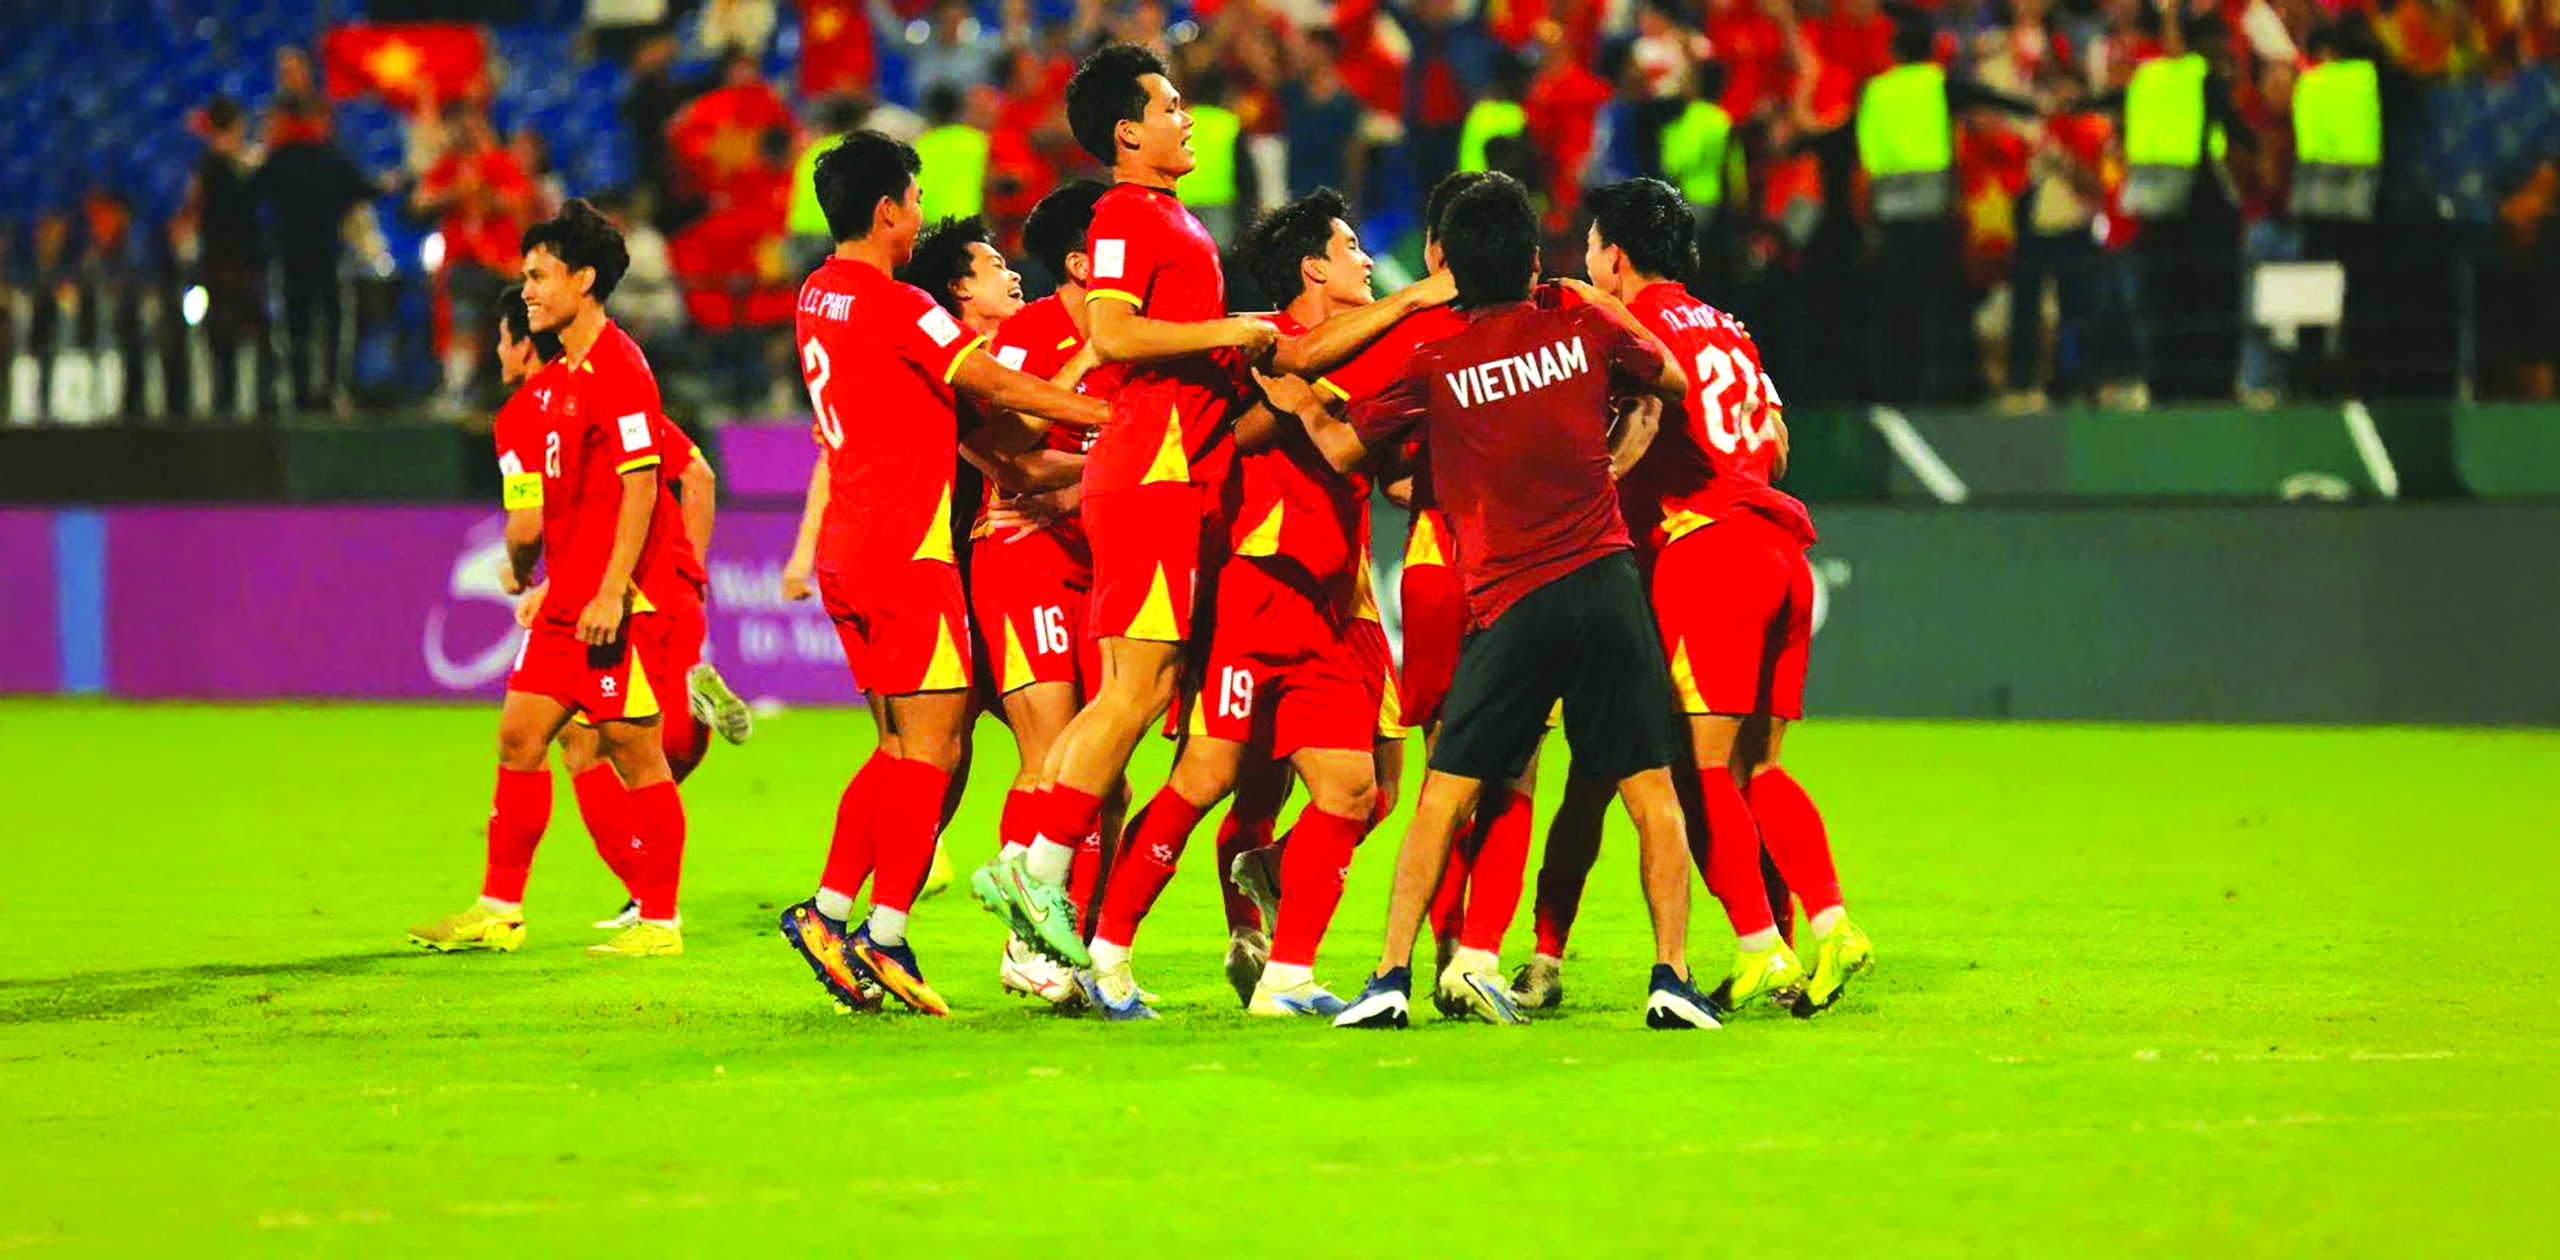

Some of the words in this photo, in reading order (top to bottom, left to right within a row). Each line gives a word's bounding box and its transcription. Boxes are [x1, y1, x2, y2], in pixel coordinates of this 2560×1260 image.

[818, 291, 856, 322] PHAT
[803, 334, 845, 451] 2
[1445, 336, 1589, 408] VIETNAM
[1032, 605, 1069, 656] 16
[1218, 665, 1254, 720] 19
